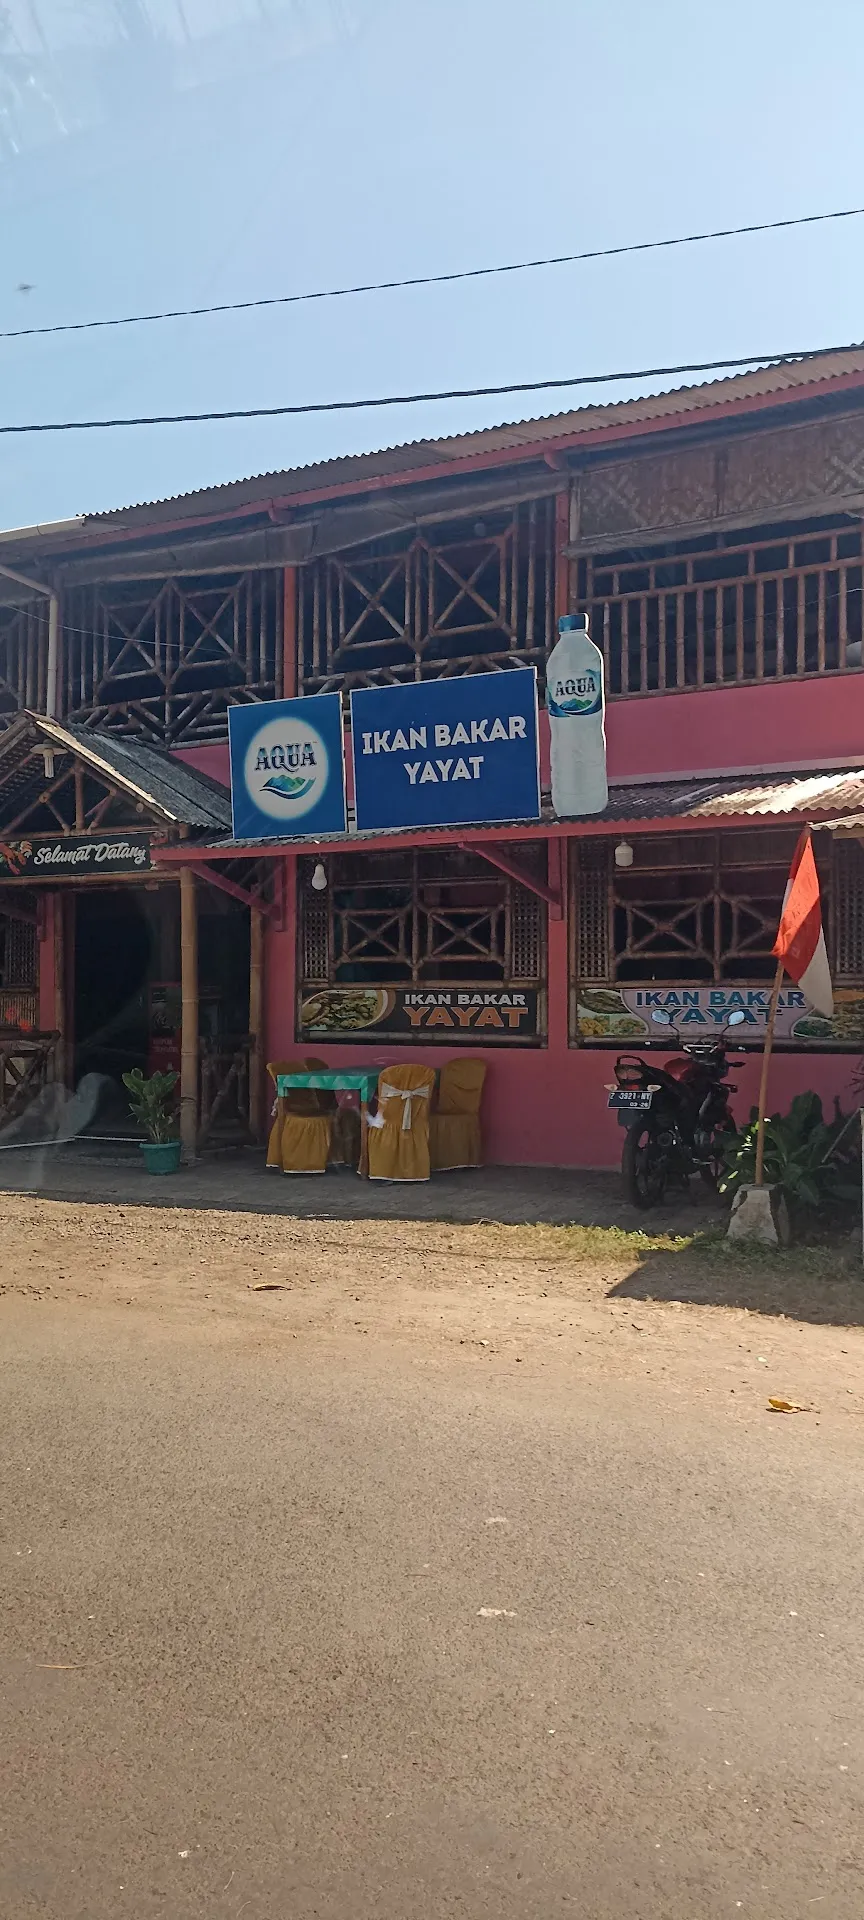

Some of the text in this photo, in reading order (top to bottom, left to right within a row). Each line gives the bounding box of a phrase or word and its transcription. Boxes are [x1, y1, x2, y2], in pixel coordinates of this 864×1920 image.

[555, 677, 597, 697] AQUA
[362, 715, 528, 755] IKAN BAKAR
[255, 742, 317, 773] AQUA
[403, 756, 485, 785] YAYAT
[33, 841, 147, 865] Selamat Datang
[404, 994, 526, 1005] IKAN BAKAR
[636, 991, 700, 1007] IKAN
[402, 1006, 529, 1028] YAYAT
